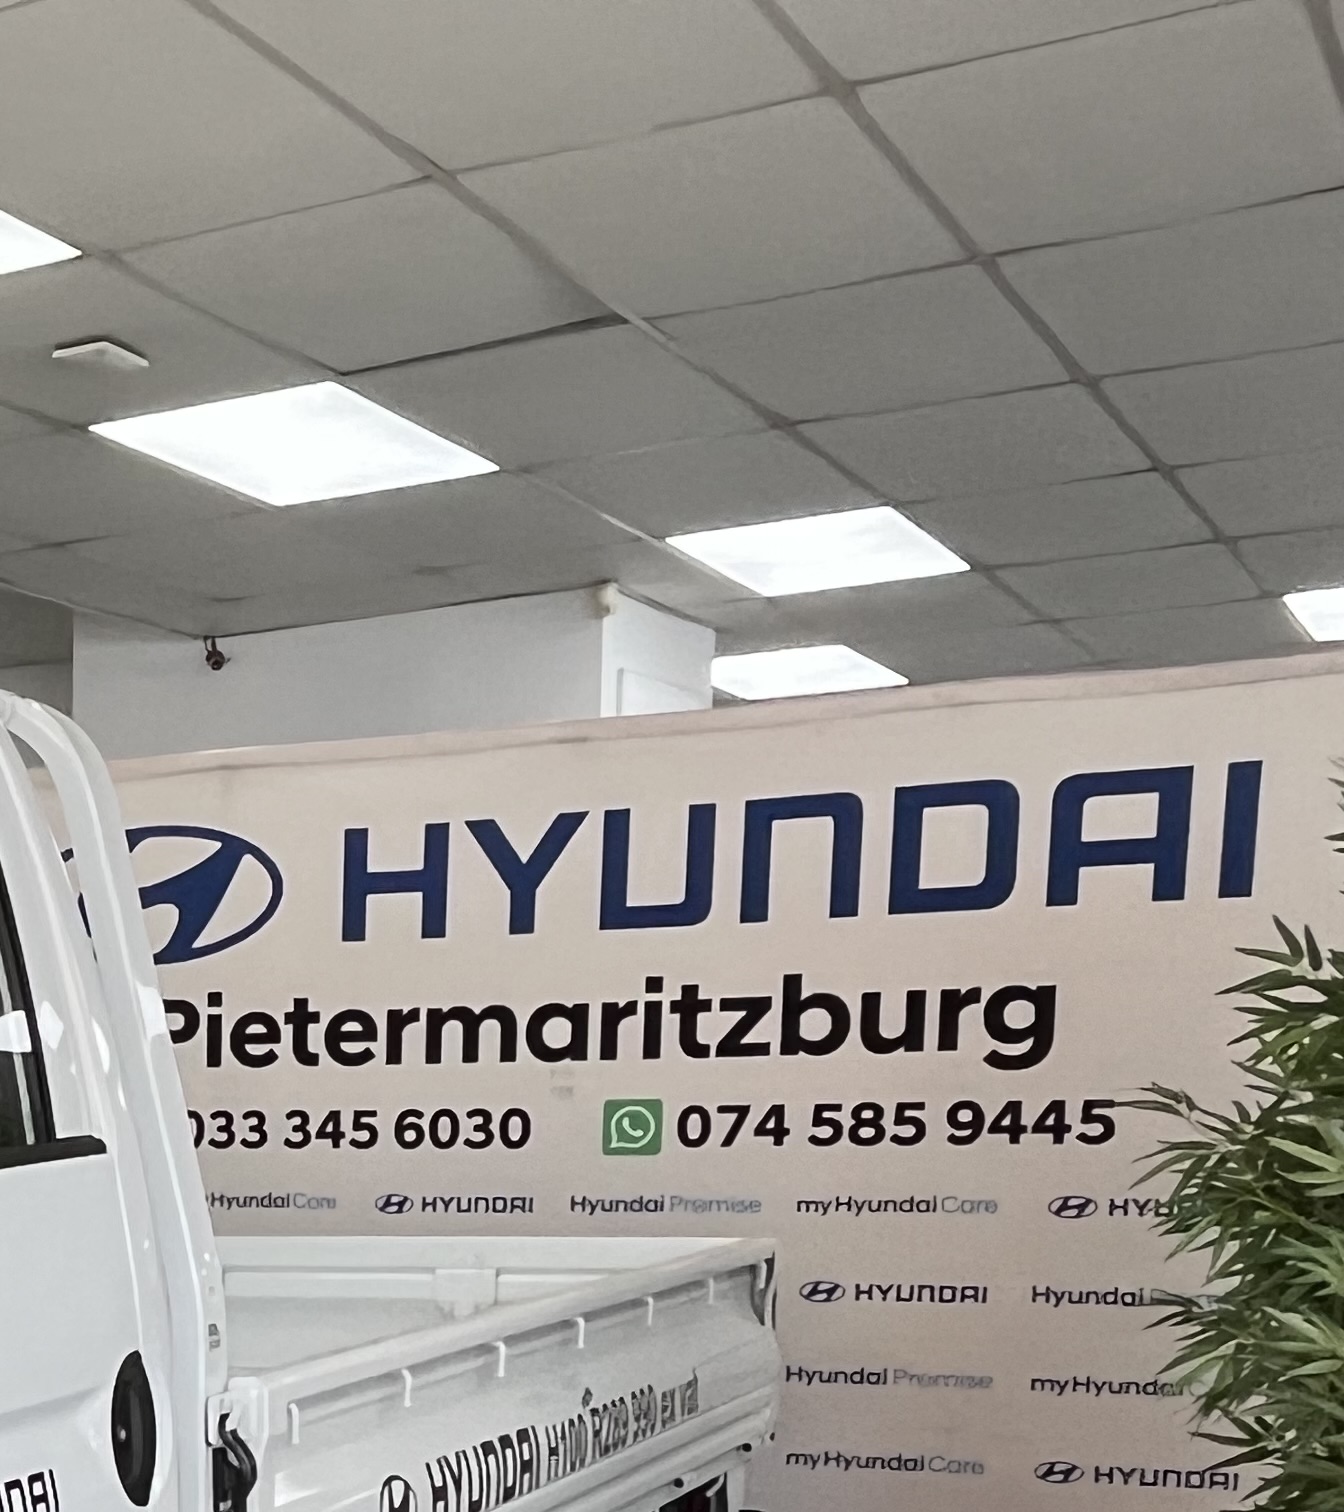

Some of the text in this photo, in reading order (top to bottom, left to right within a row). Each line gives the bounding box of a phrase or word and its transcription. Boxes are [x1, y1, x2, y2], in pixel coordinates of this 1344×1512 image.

[341, 760, 1264, 942] HYUNDAI
[162, 974, 1057, 1071] Pietermaritzburg
[283, 1109, 379, 1150] 345
[393, 1107, 532, 1150] 6030
[676, 1103, 791, 1149] 074
[808, 1101, 927, 1147] 585
[946, 1099, 1117, 1146] 9445
[205, 1191, 290, 1211] Hyundai
[421, 1196, 534, 1214] HYUNDAI
[854, 1283, 988, 1304] HYUNDAI
[1094, 1465, 1240, 1492] HYUNDAI
